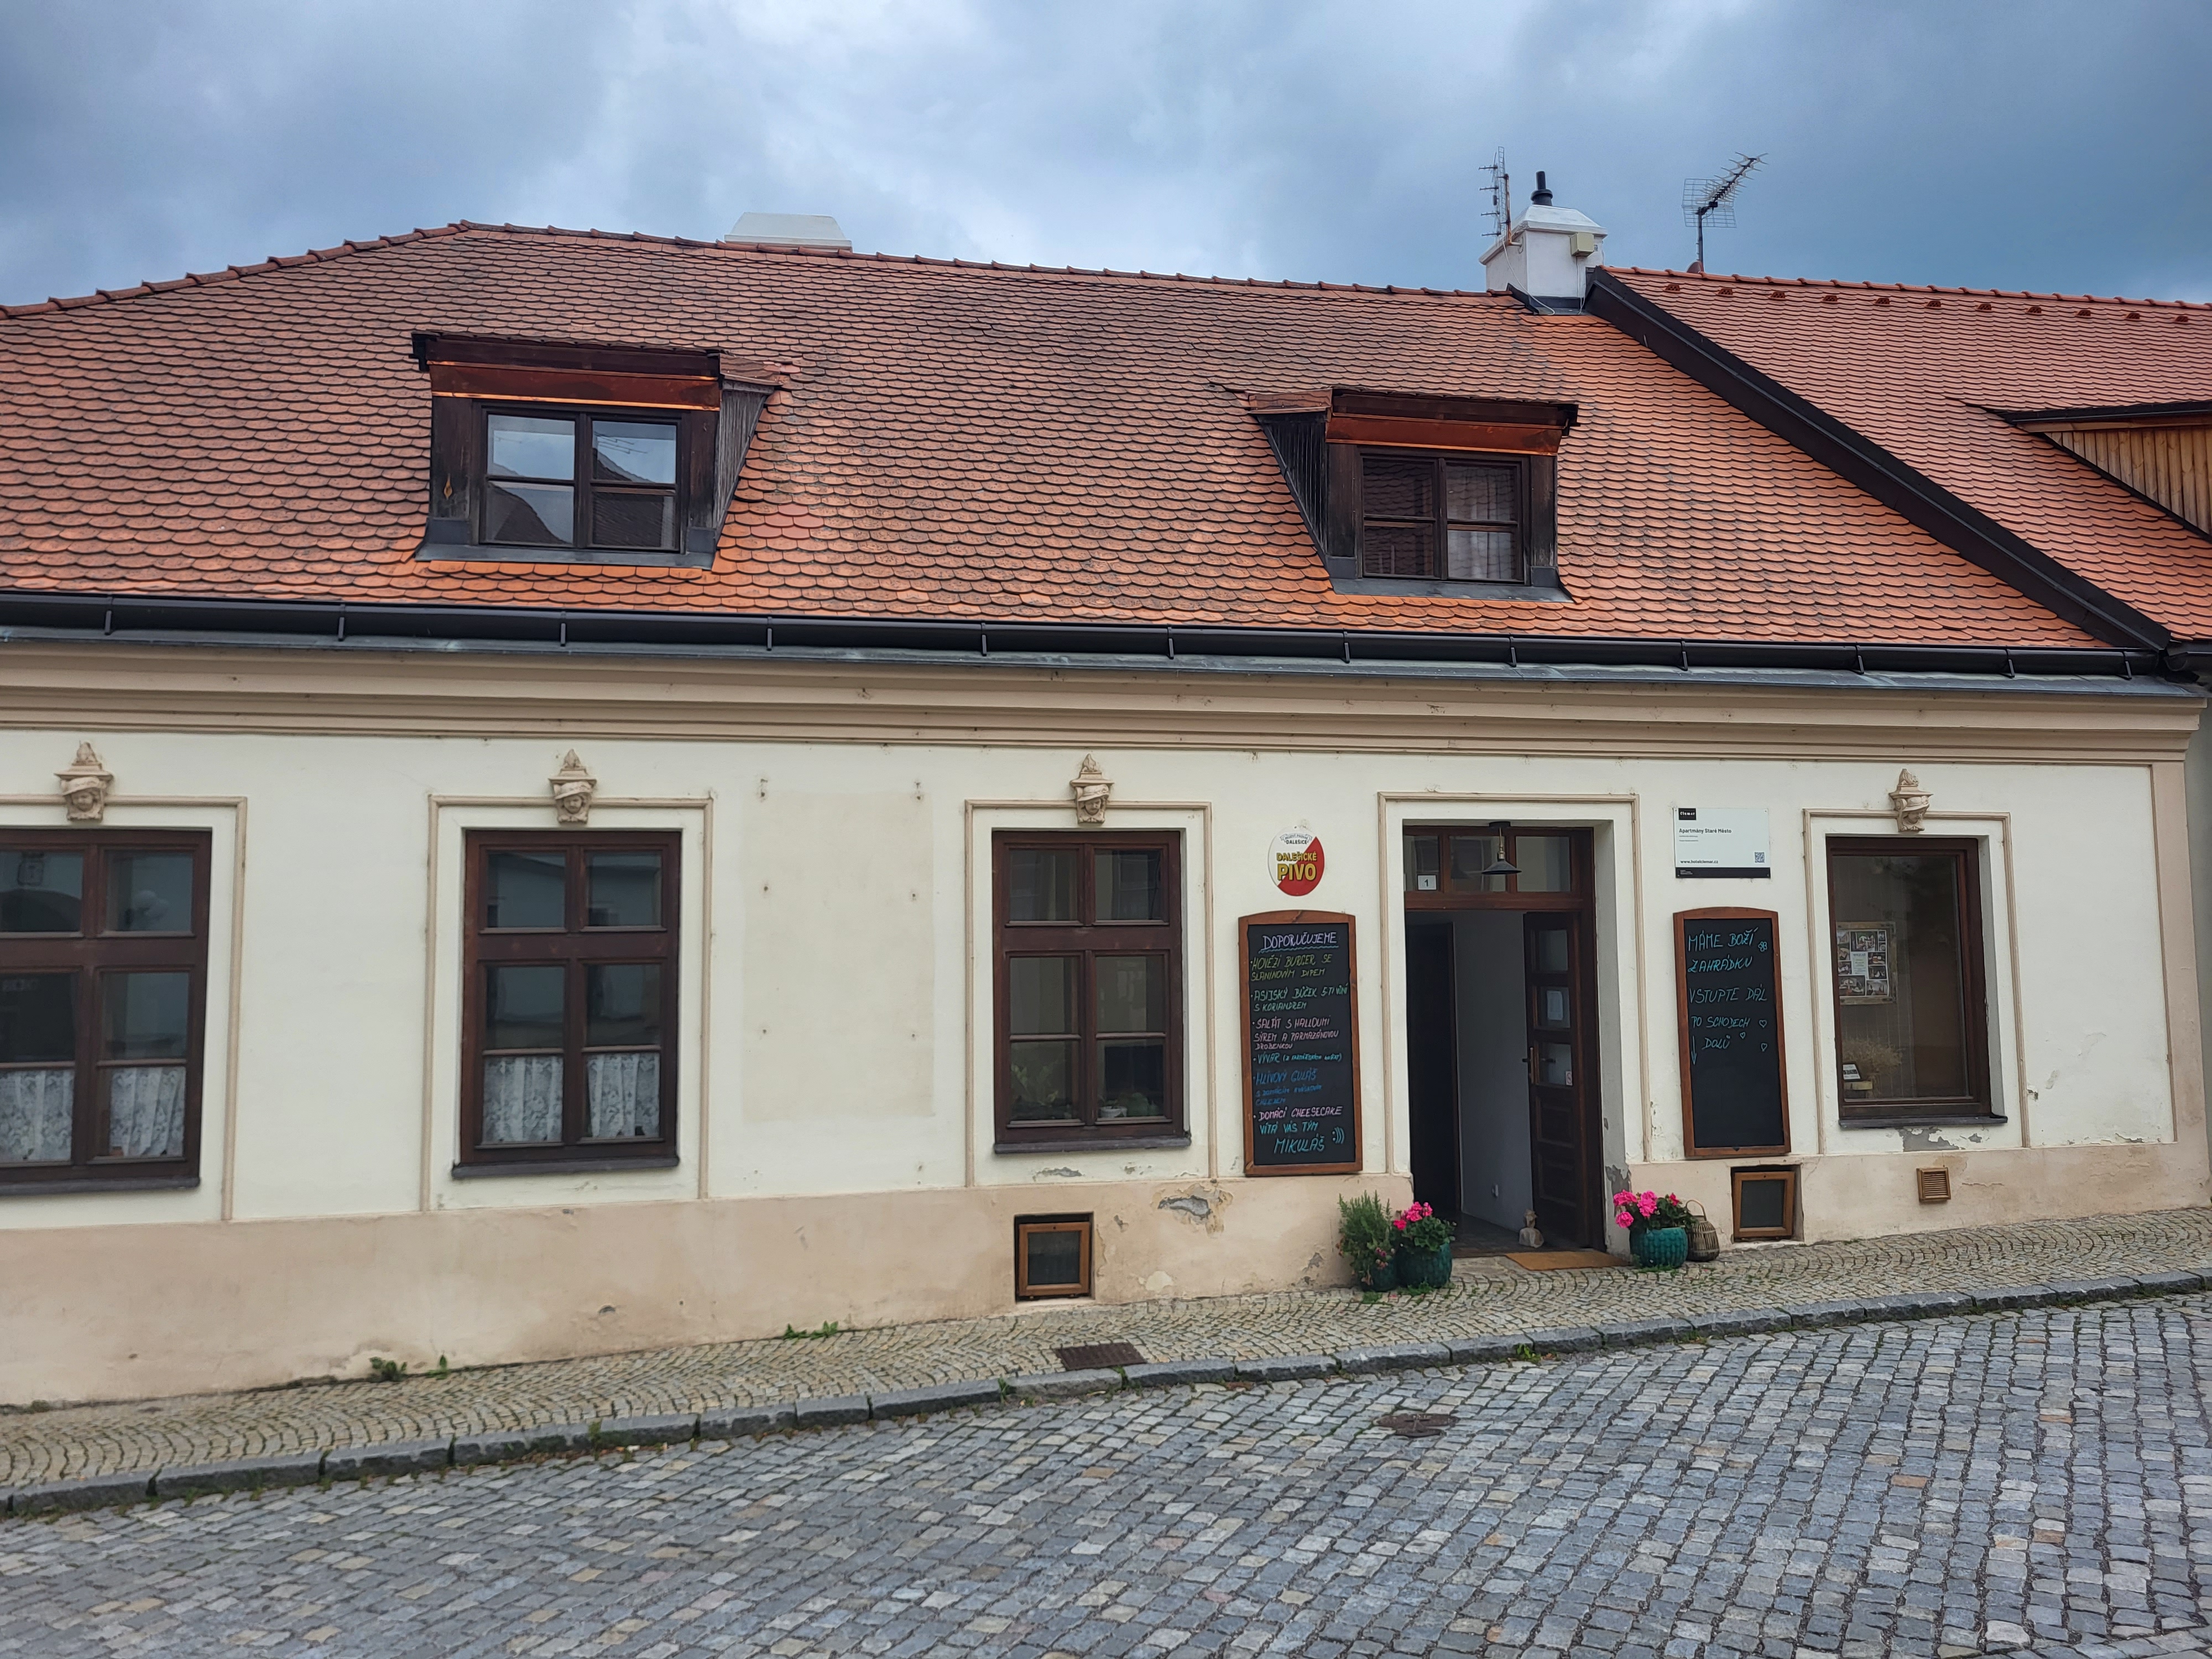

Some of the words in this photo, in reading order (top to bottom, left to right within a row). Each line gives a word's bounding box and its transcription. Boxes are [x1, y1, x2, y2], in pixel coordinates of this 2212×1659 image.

[1276, 851, 1317, 862] DALEŠICKÉ
[1277, 863, 1317, 881] PIVO
[1424, 879, 1430, 888] 1
[1261, 932, 1337, 950] DOPORUČUJEME
[1688, 930, 1723, 952] MÁME
[1728, 927, 1759, 947] BOŽÍ
[1321, 954, 1333, 963] SE
[1687, 954, 1753, 973] ZAHRÁDKU
[1254, 987, 1288, 1001] ASIJSKÝ
[1689, 987, 1740, 1004] VSTUPTE
[1745, 983, 1767, 1001] DÁL
[1254, 1003, 1260, 1011] S
[1262, 1001, 1307, 1012] KORIANDREM
[1255, 1016, 1281, 1029] SALÁT
[1285, 1018, 1292, 1029] S
[1691, 1016, 1702, 1029] PO
[1705, 1016, 1751, 1029] SCHODECH
[1281, 1032, 1287, 1042] A
[1702, 1035, 1731, 1050] DOLŮ
[1258, 1106, 1288, 1121] DOMÁCÍ
[1291, 1106, 1343, 1118] CHEESECAKE
[1274, 1134, 1325, 1154] MIKULÁŠ
